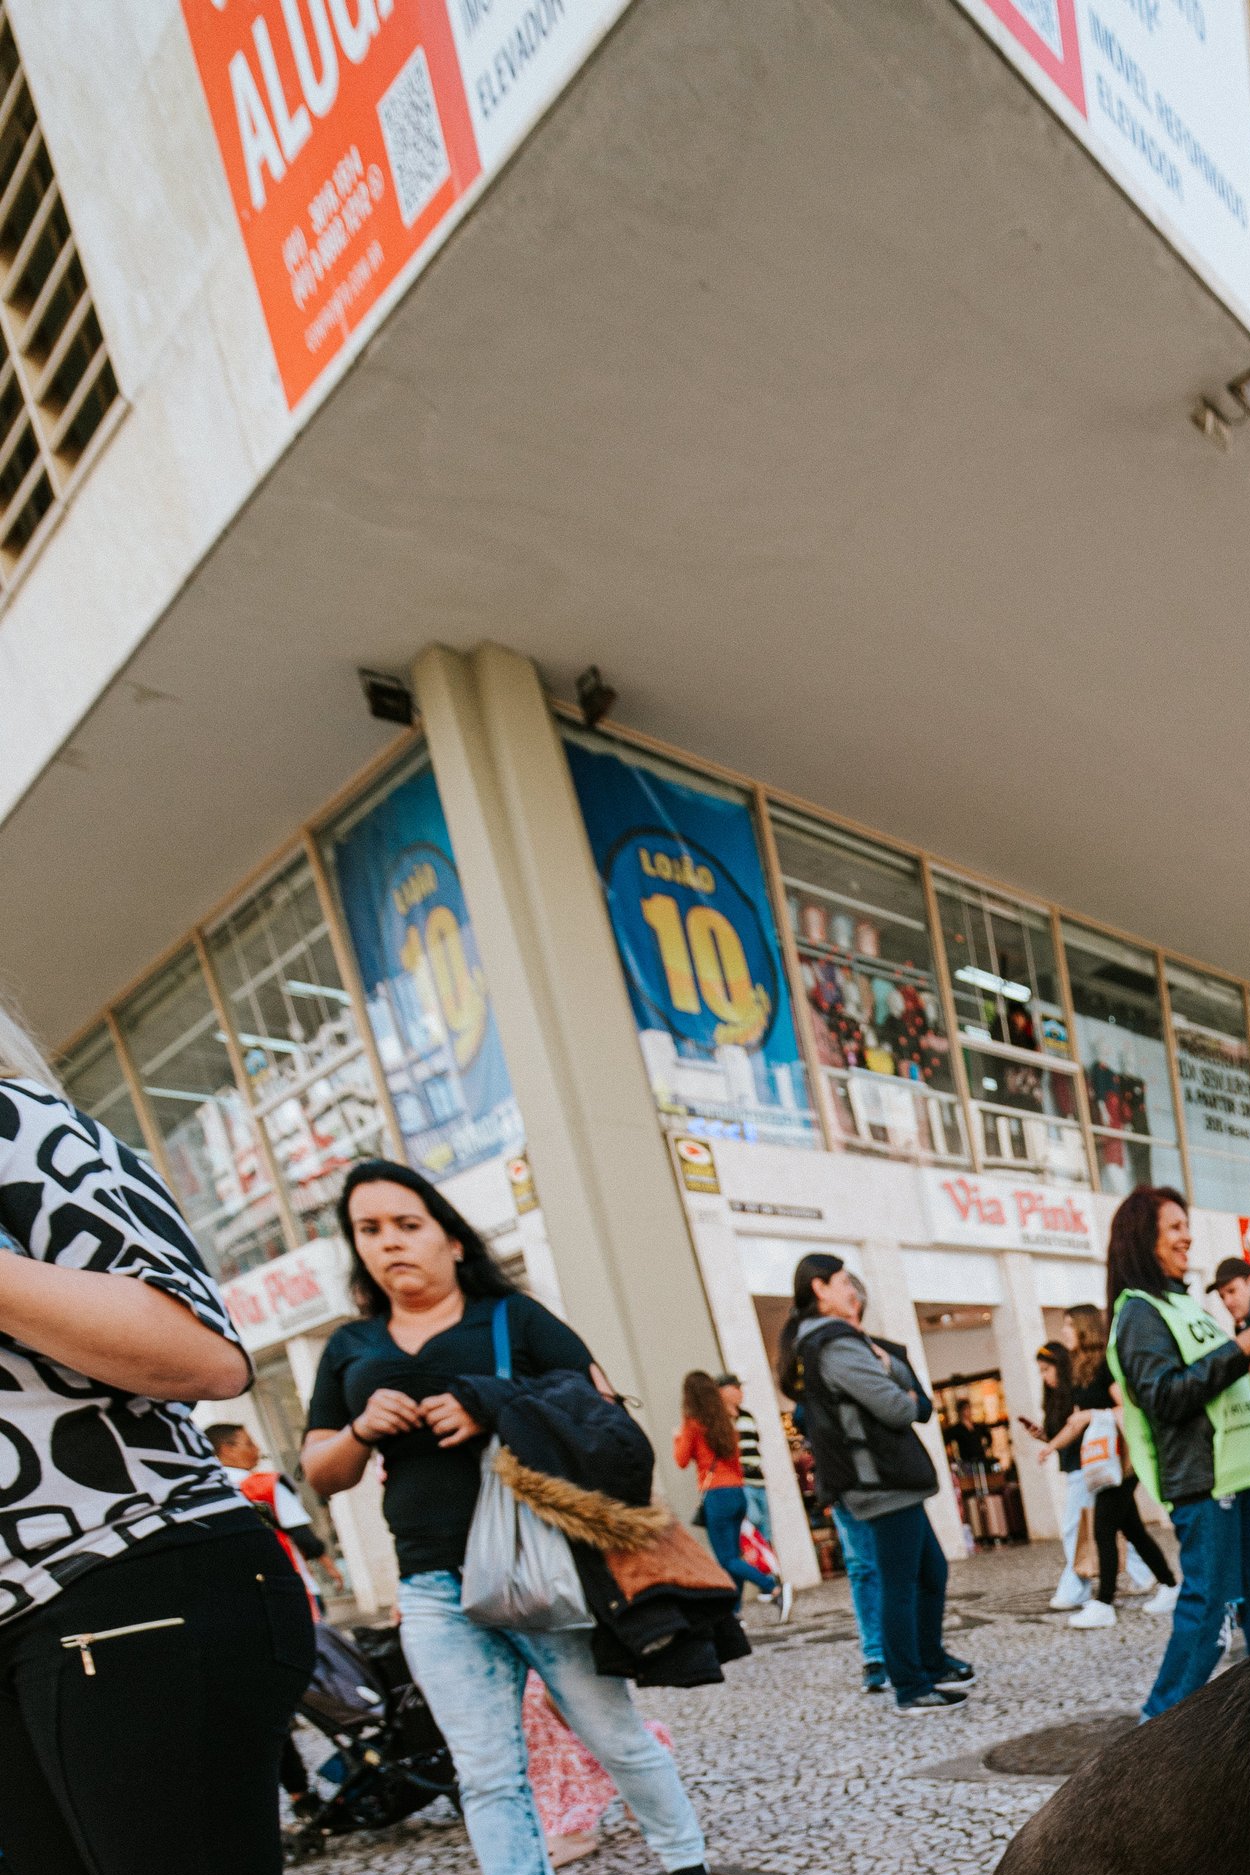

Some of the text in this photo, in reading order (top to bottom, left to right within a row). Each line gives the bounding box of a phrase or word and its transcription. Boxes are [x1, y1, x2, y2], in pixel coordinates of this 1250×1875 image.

[475, 0, 565, 119] ELEVADO
[941, 1176, 1088, 1233] Via Pink
